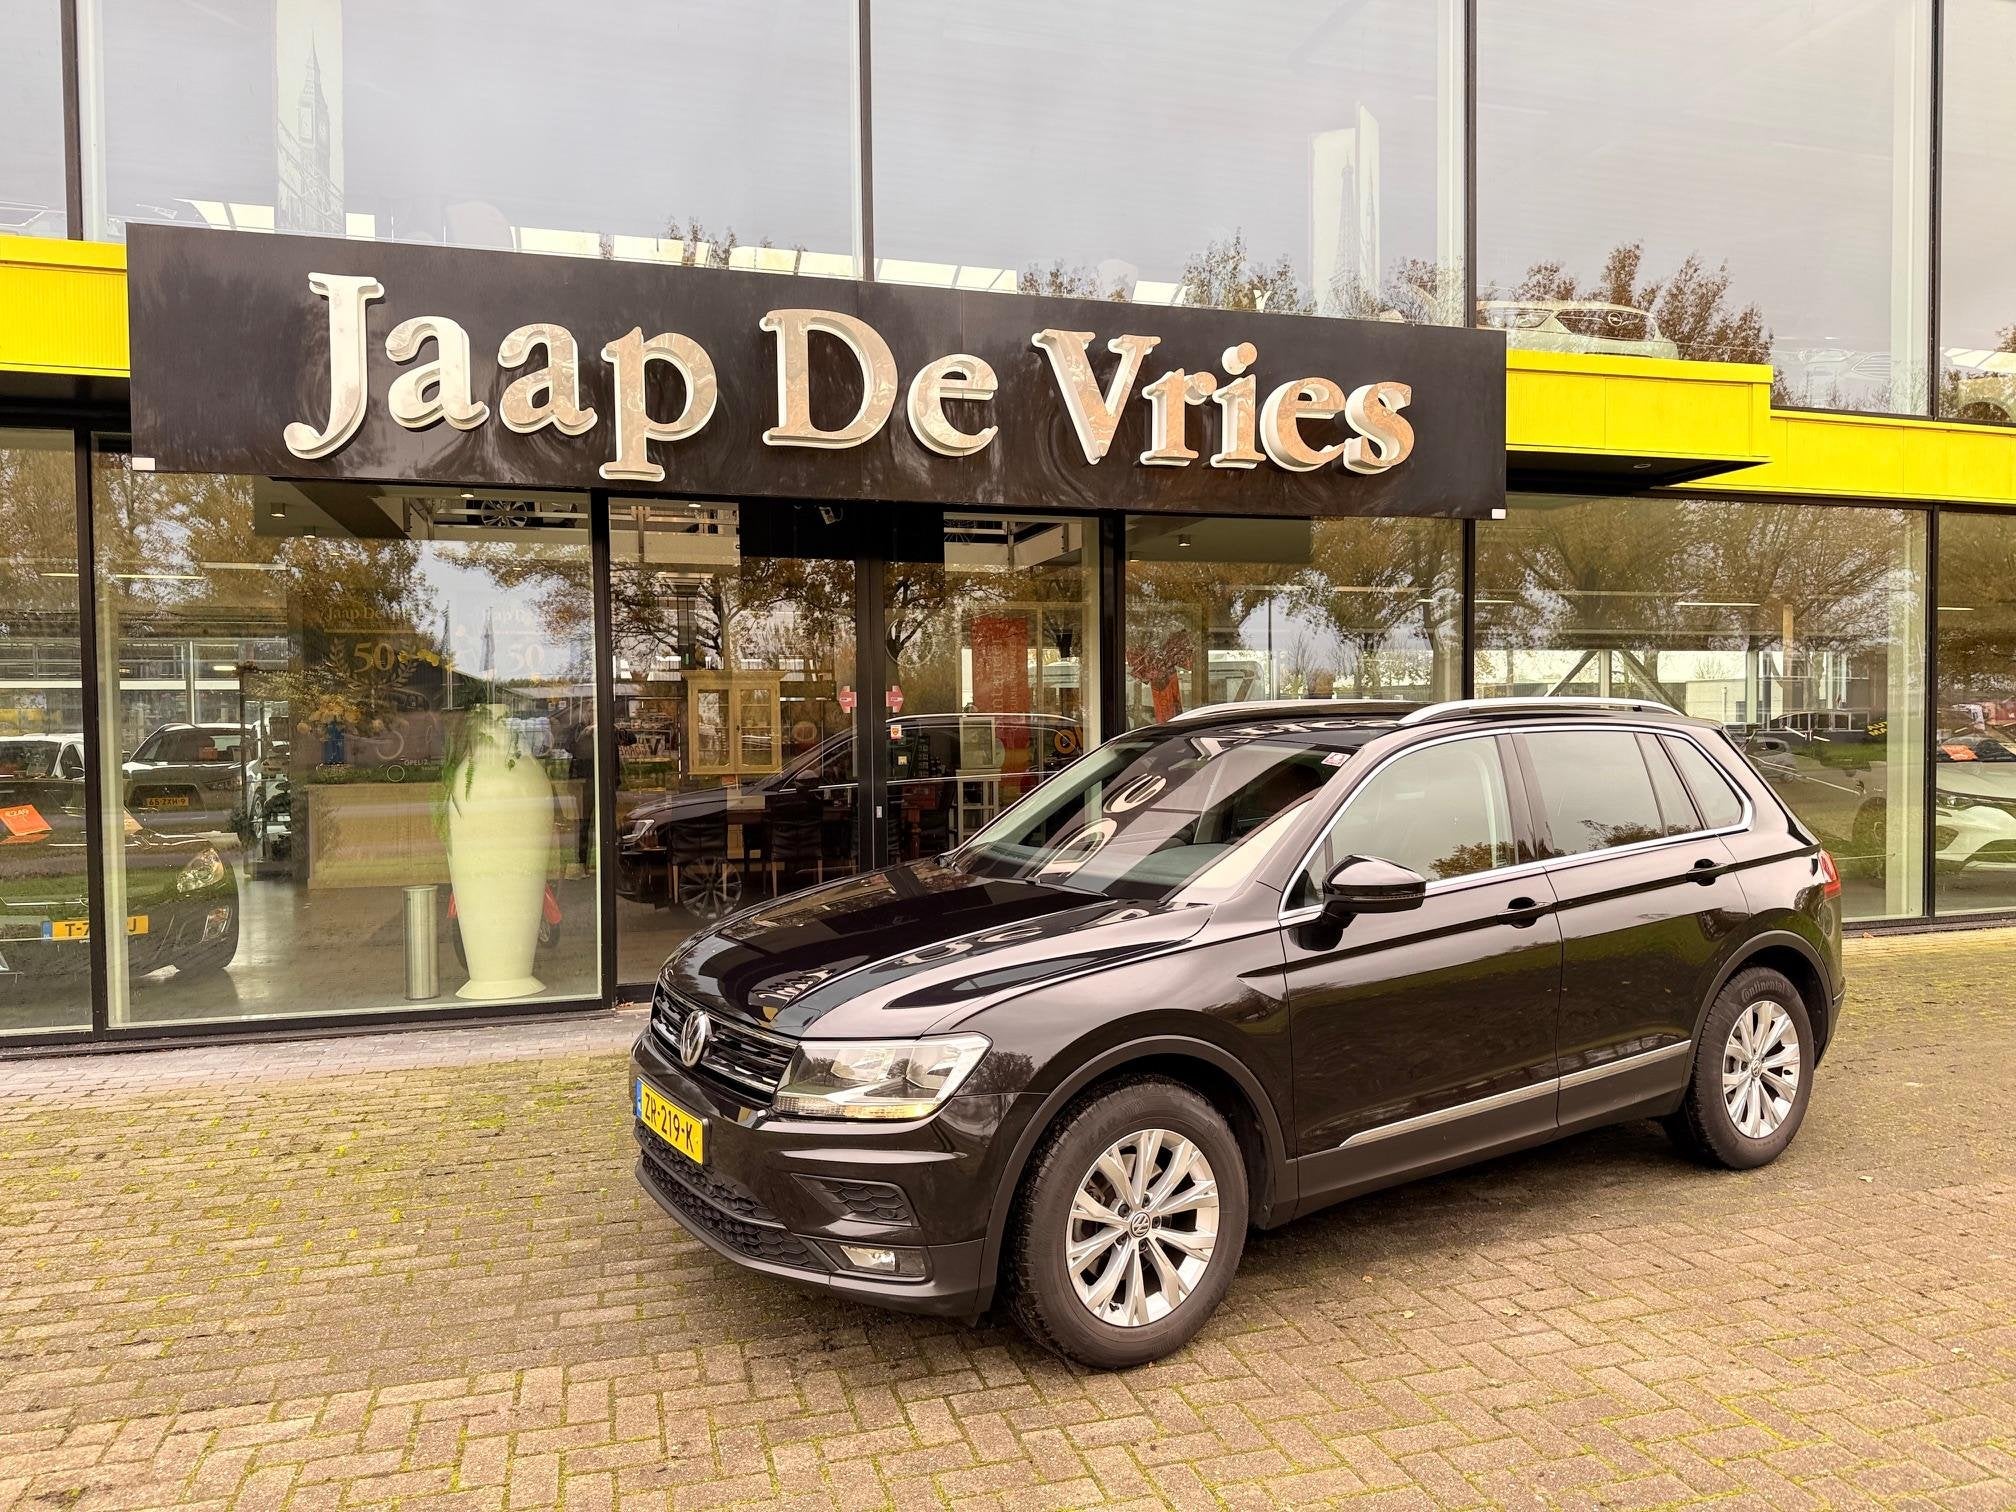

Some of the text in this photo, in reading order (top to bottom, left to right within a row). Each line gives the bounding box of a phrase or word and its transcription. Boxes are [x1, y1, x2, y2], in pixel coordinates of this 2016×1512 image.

[283, 272, 1415, 482] Jaap De Vries
[353, 641, 395, 673] 50
[645, 1092, 694, 1153] ZR-219-K
